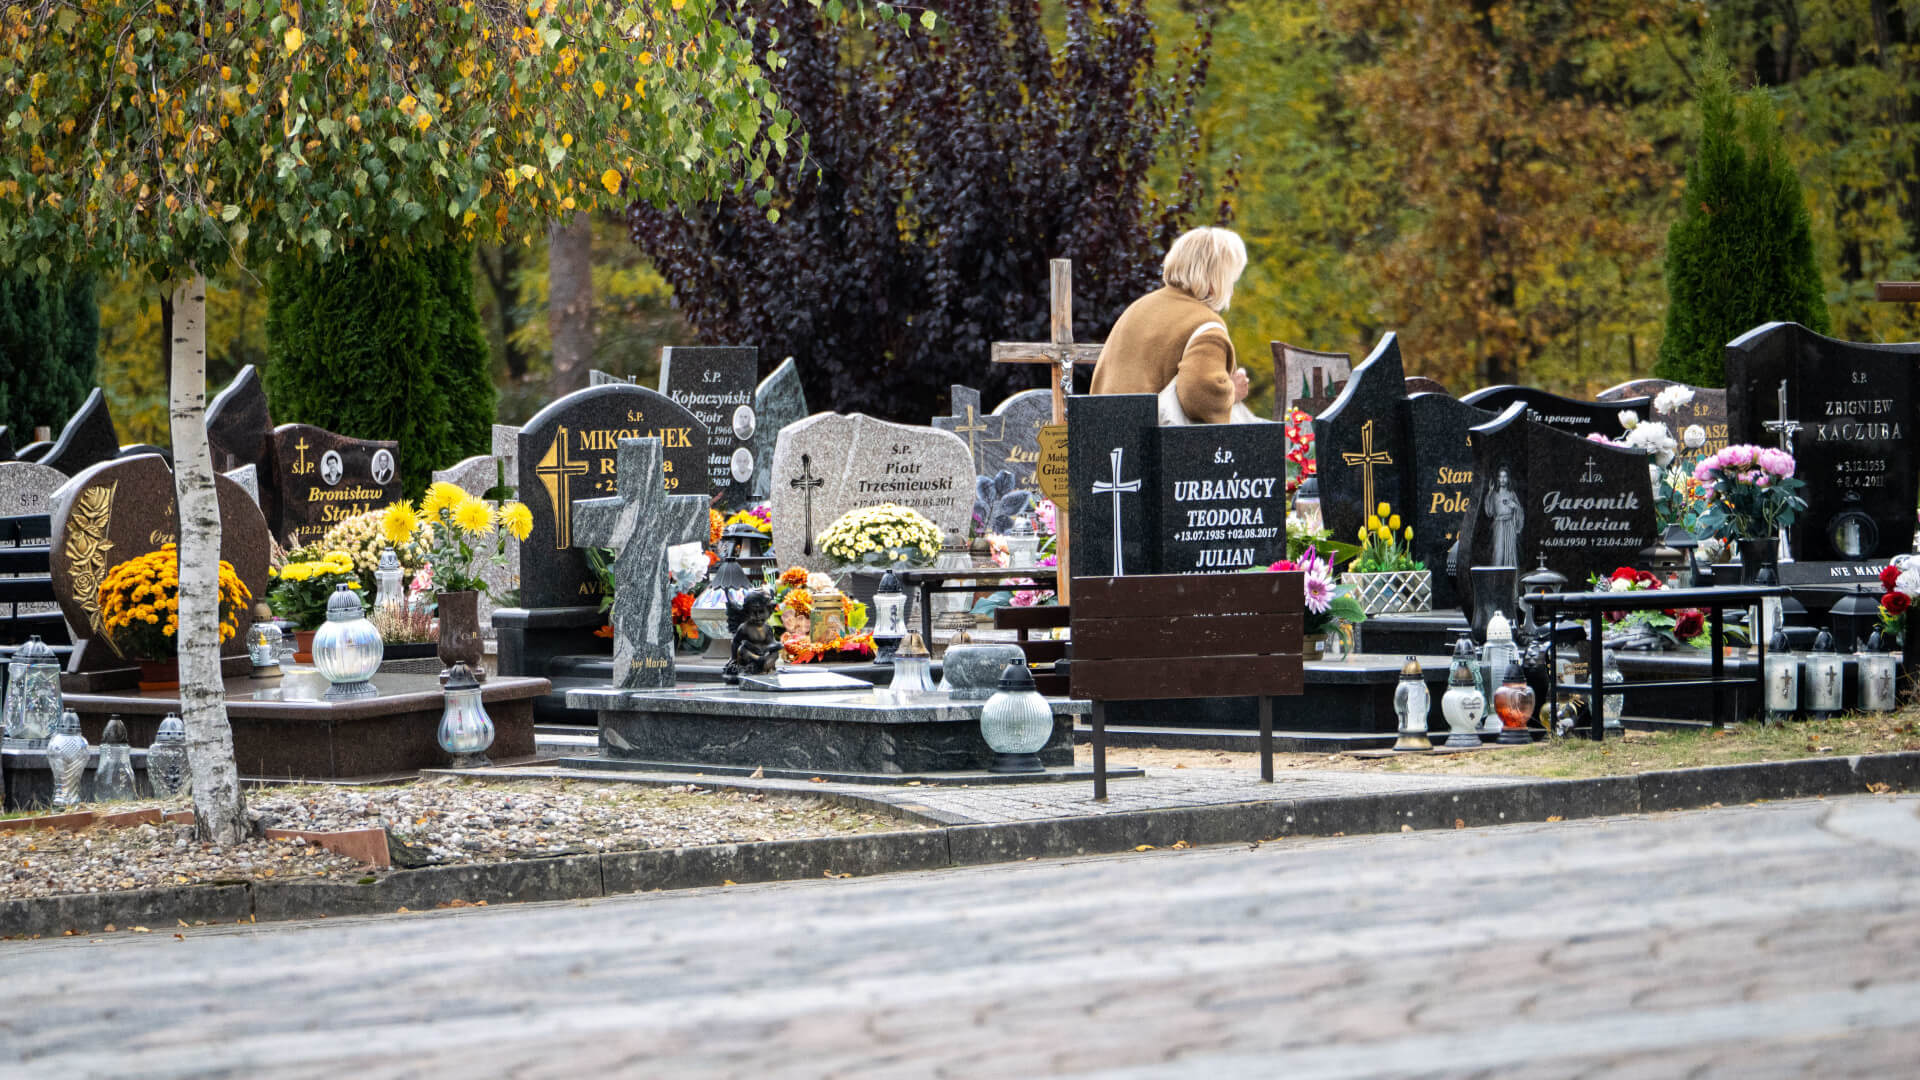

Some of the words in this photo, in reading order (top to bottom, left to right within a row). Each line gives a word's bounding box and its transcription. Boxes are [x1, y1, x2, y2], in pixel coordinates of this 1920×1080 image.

[702, 369, 721, 383] Ś.P.
[671, 389, 751, 409] Kopaczyński
[1825, 400, 1893, 415] ZBIGNIEW
[627, 409, 644, 422] Ś.P.
[696, 411, 724, 424] Piotr
[1677, 424, 1729, 440] TASZ
[1817, 422, 1902, 441] KACZUBA
[891, 443, 912, 455] Ś.P.
[1215, 446, 1235, 463] Ś.P.
[886, 463, 922, 475] Piotr
[1437, 466, 1472, 485] Stan
[308, 485, 383, 502] Bronisław
[859, 477, 953, 494] Trześniewski
[1174, 472, 1276, 501] URBAŃSCY
[1429, 491, 1470, 513] Pole
[1542, 491, 1640, 514] Jaromik
[1187, 507, 1265, 528] TEODORA
[1551, 516, 1631, 532] Walerian
[1196, 549, 1254, 567] JULIAN
[1830, 566, 1850, 577] AVE
[1854, 565, 1888, 577] MARI
[645, 656, 668, 668] Maria
